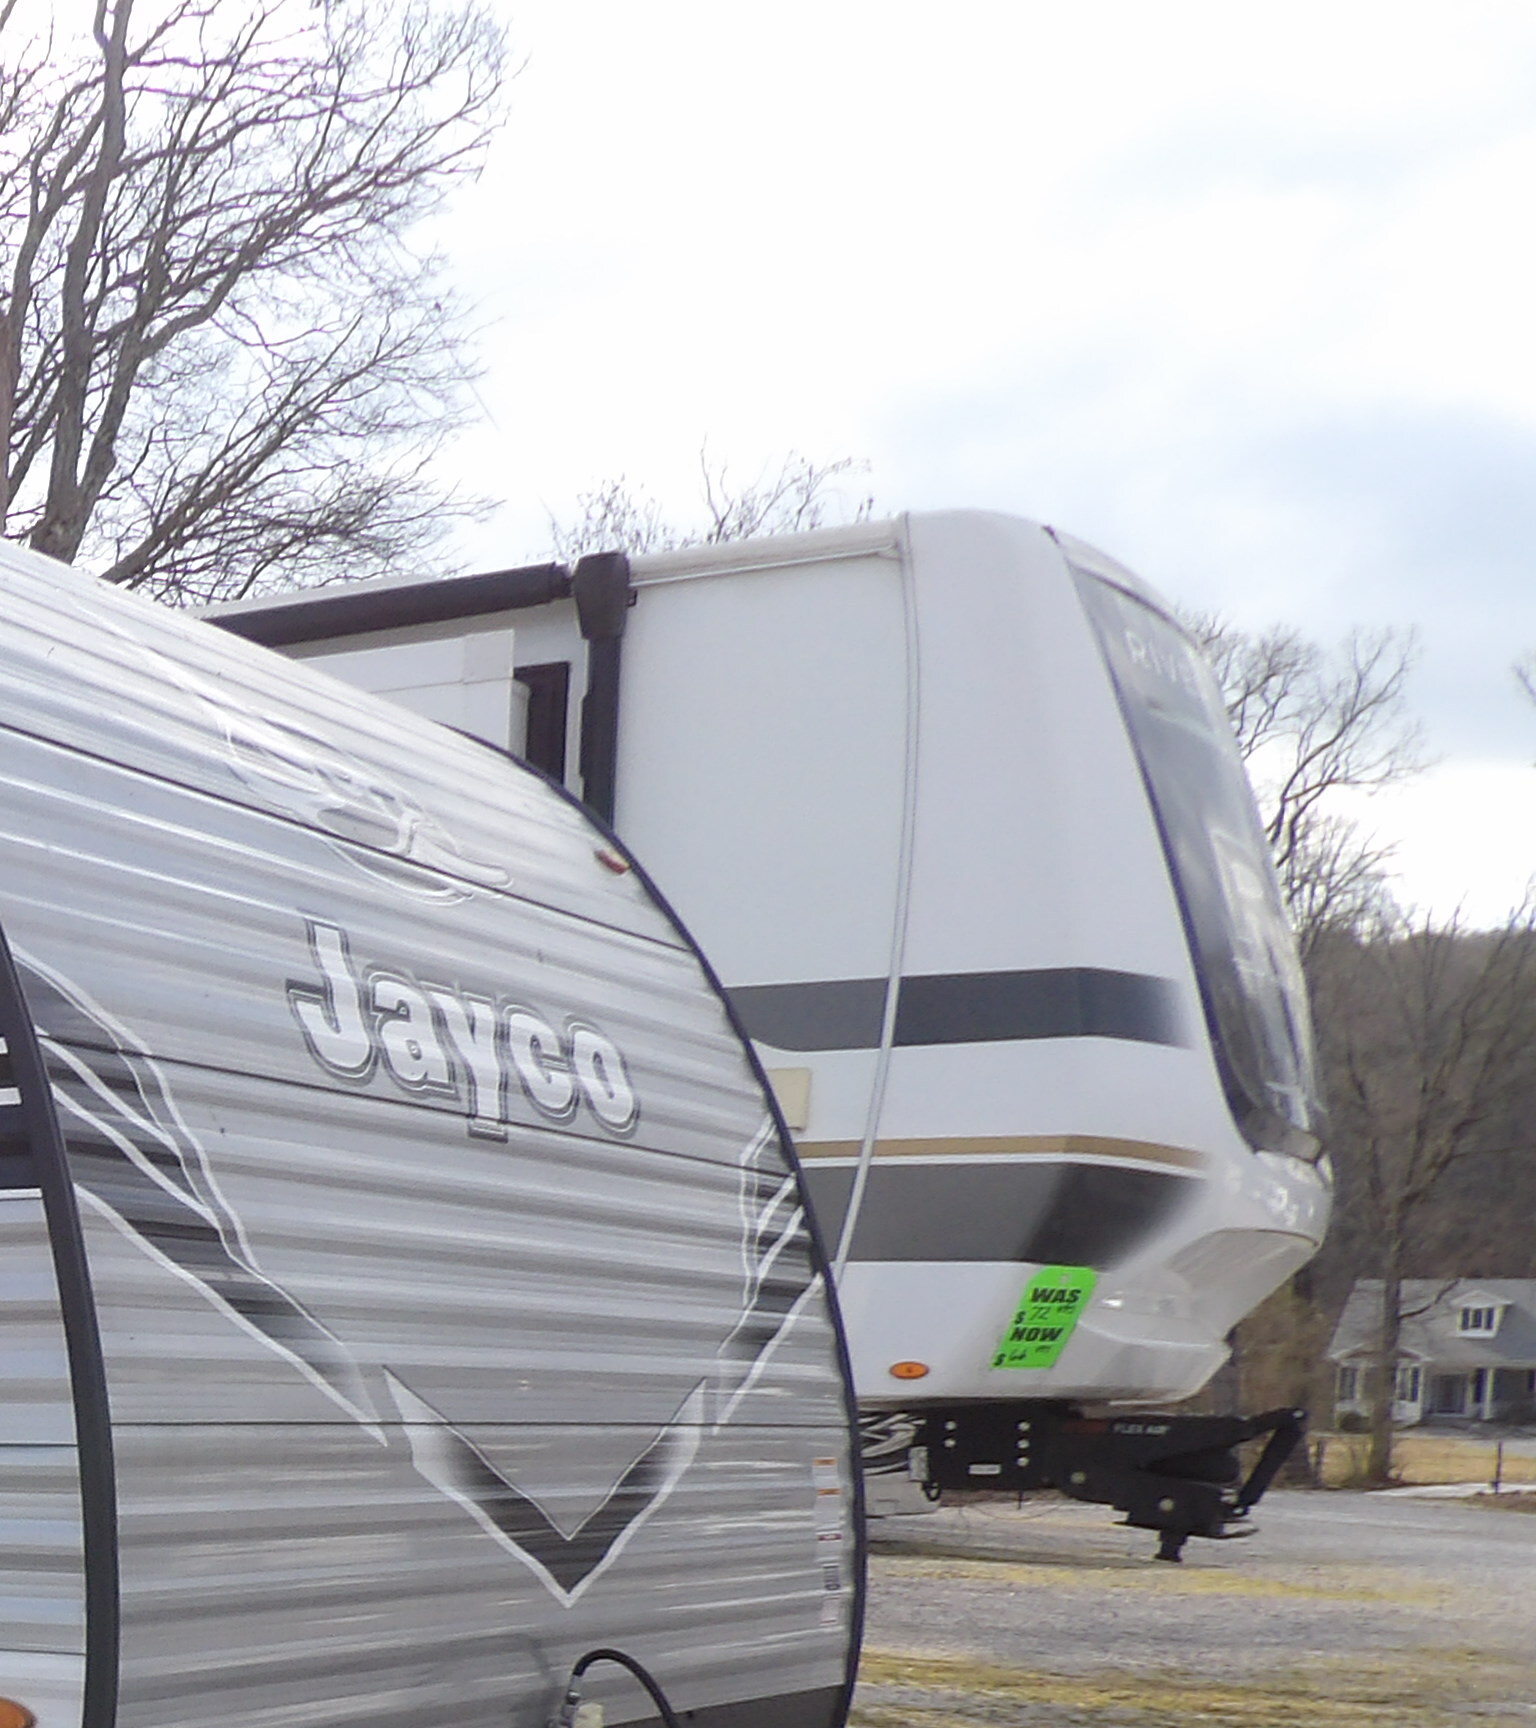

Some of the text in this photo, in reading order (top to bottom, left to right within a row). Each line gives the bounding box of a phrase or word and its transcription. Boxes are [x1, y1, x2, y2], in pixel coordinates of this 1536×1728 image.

[285, 918, 640, 1142] Jayco
[1031, 1287, 1081, 1304] WAS
[1009, 1326, 1064, 1342] NOW
